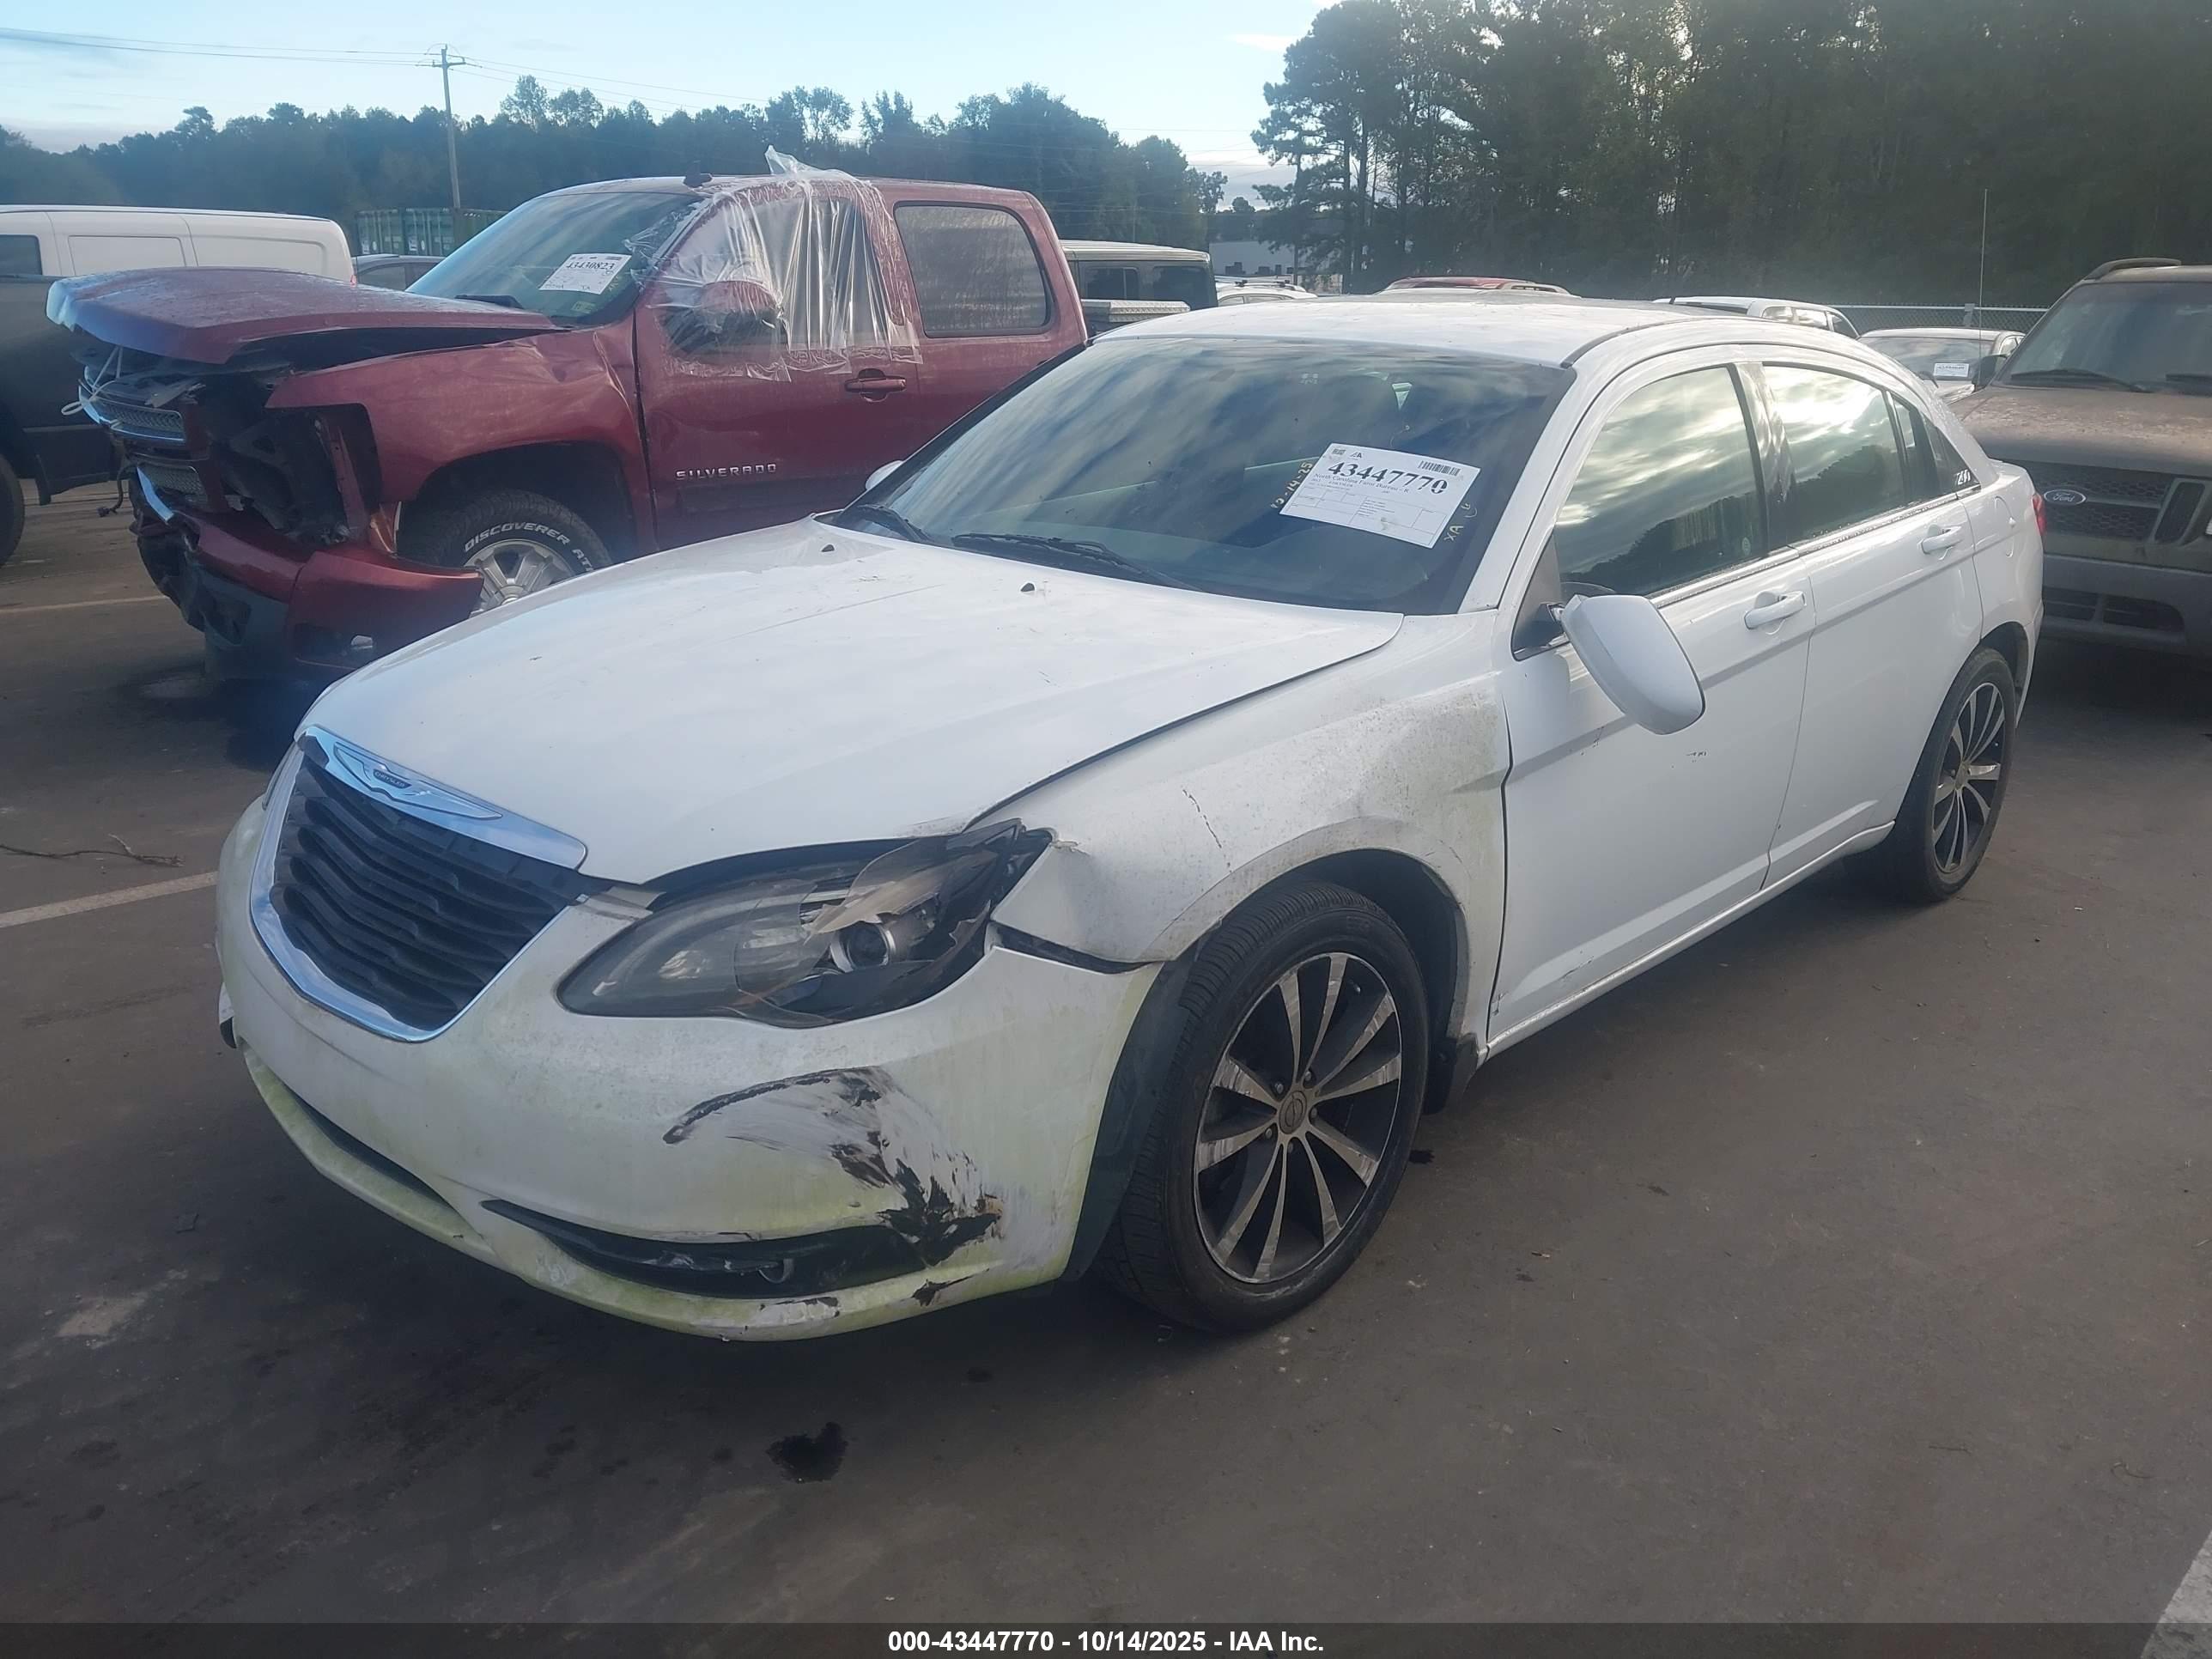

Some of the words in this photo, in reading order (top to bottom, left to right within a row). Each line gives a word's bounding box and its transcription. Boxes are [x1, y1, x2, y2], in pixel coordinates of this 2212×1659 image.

[676, 464, 777, 480] SILVERADO
[1328, 462, 1449, 495] 43447770
[464, 521, 571, 552] DISCOVERER
